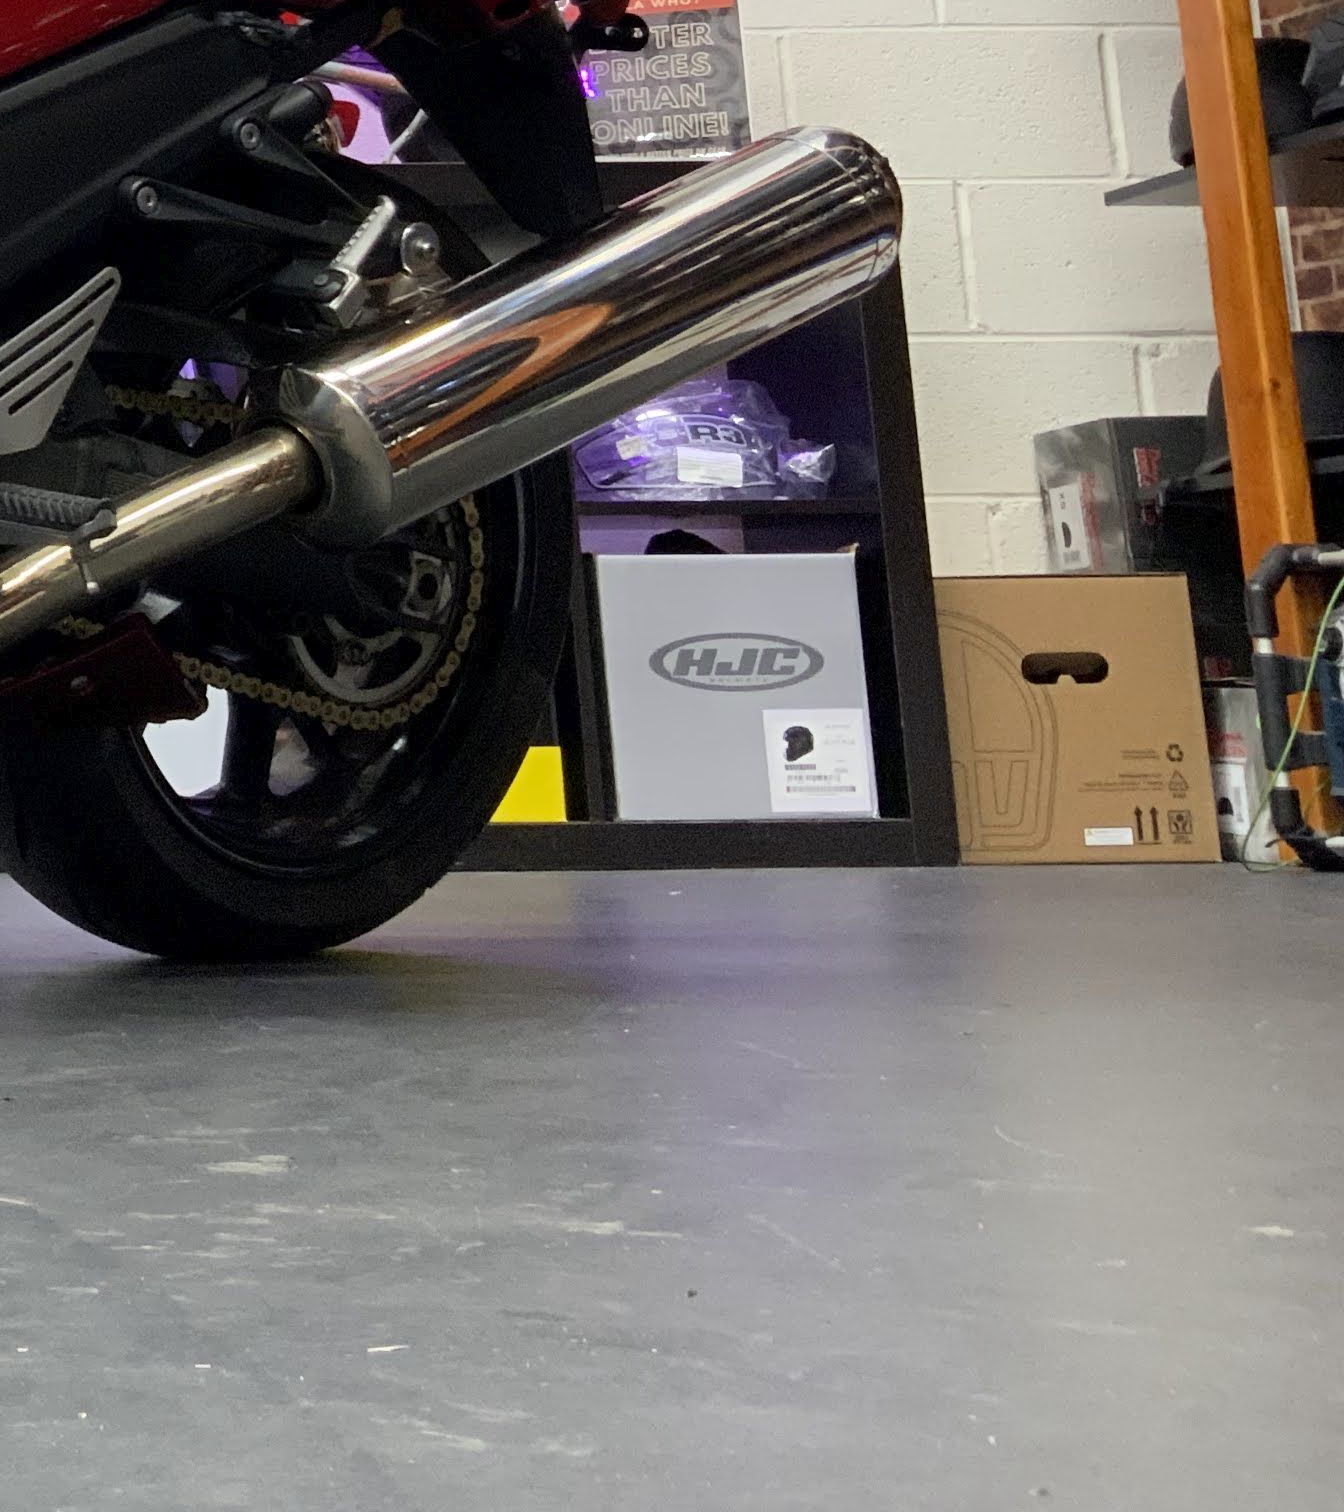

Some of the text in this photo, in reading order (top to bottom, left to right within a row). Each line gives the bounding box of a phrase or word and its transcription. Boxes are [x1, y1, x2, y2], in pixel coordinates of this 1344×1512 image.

[588, 51, 713, 85] PRICES
[605, 82, 707, 114] THAN
[590, 111, 730, 146] ONLINE!
[672, 647, 801, 677] HJC
